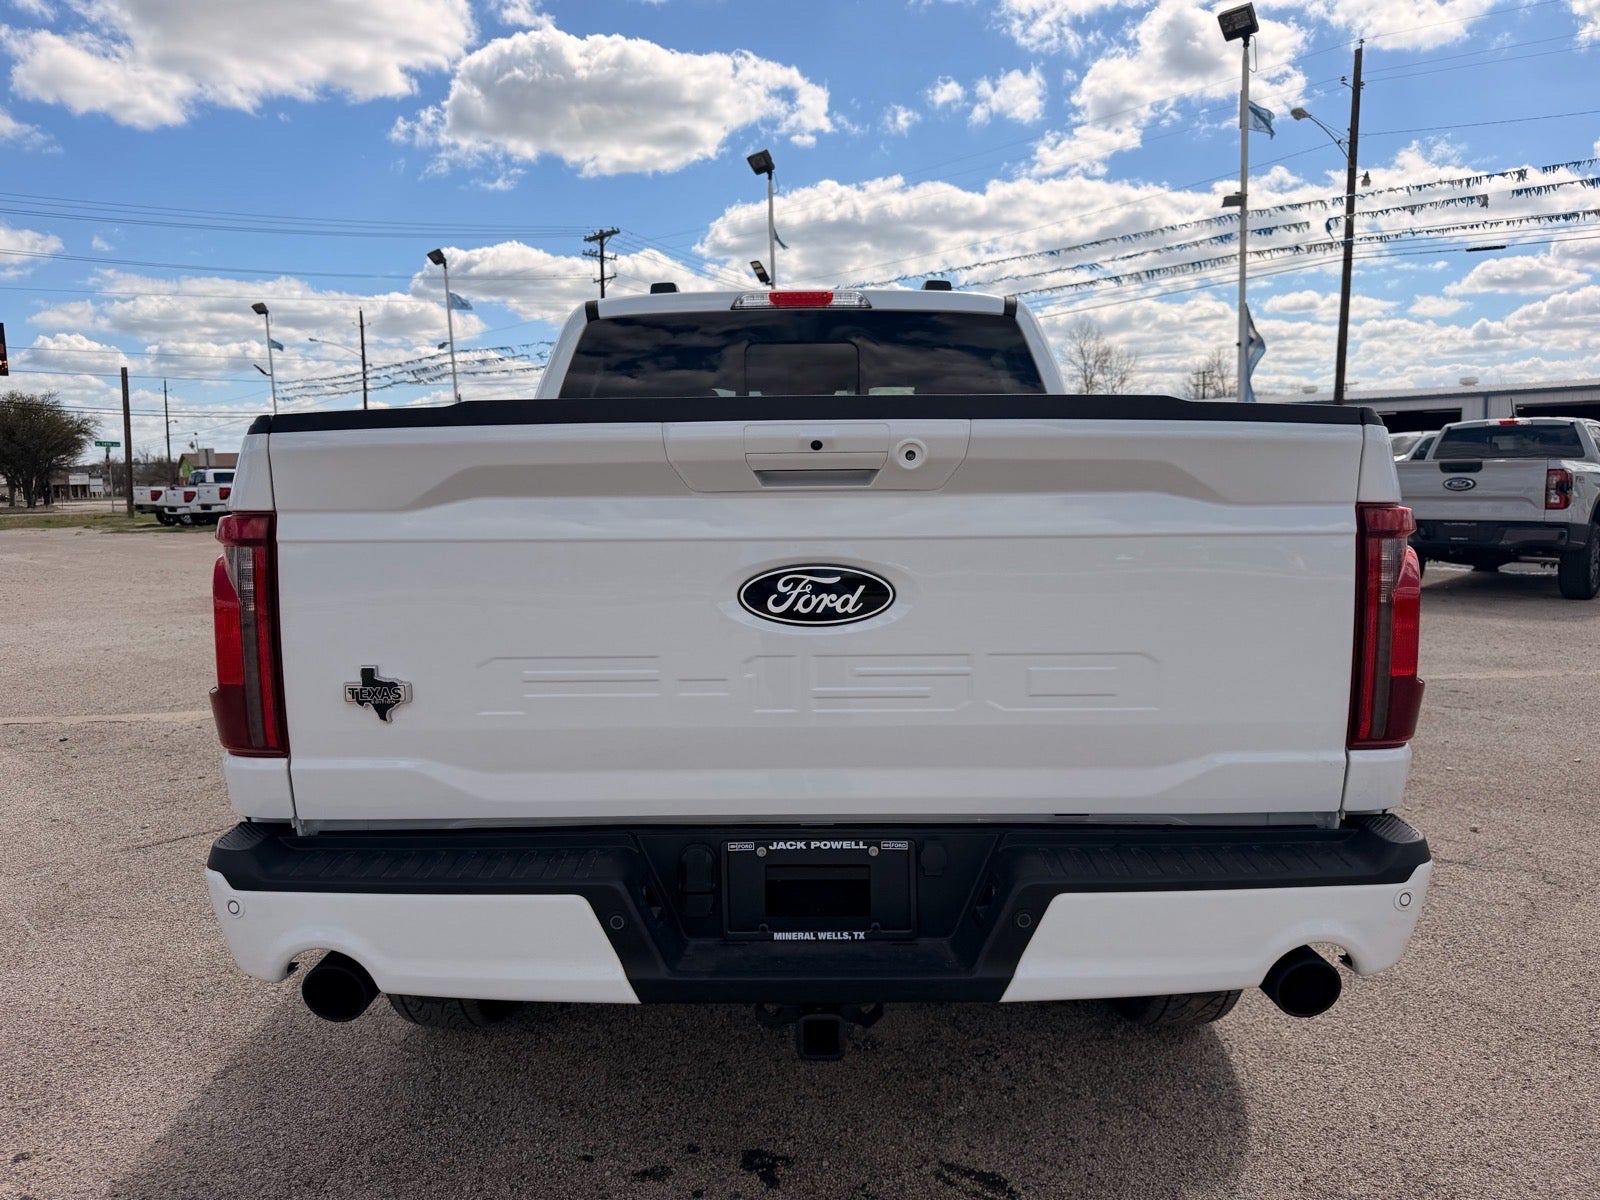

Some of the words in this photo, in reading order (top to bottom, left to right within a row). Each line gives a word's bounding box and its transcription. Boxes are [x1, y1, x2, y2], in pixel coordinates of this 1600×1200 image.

[767, 574, 866, 613] Ford
[347, 686, 402, 700] TEXAS
[769, 841, 807, 849] JACK
[811, 841, 867, 849] POWELL
[774, 932, 816, 940] MINERAL
[818, 932, 851, 941] WELLS,
[853, 932, 865, 940] TX
